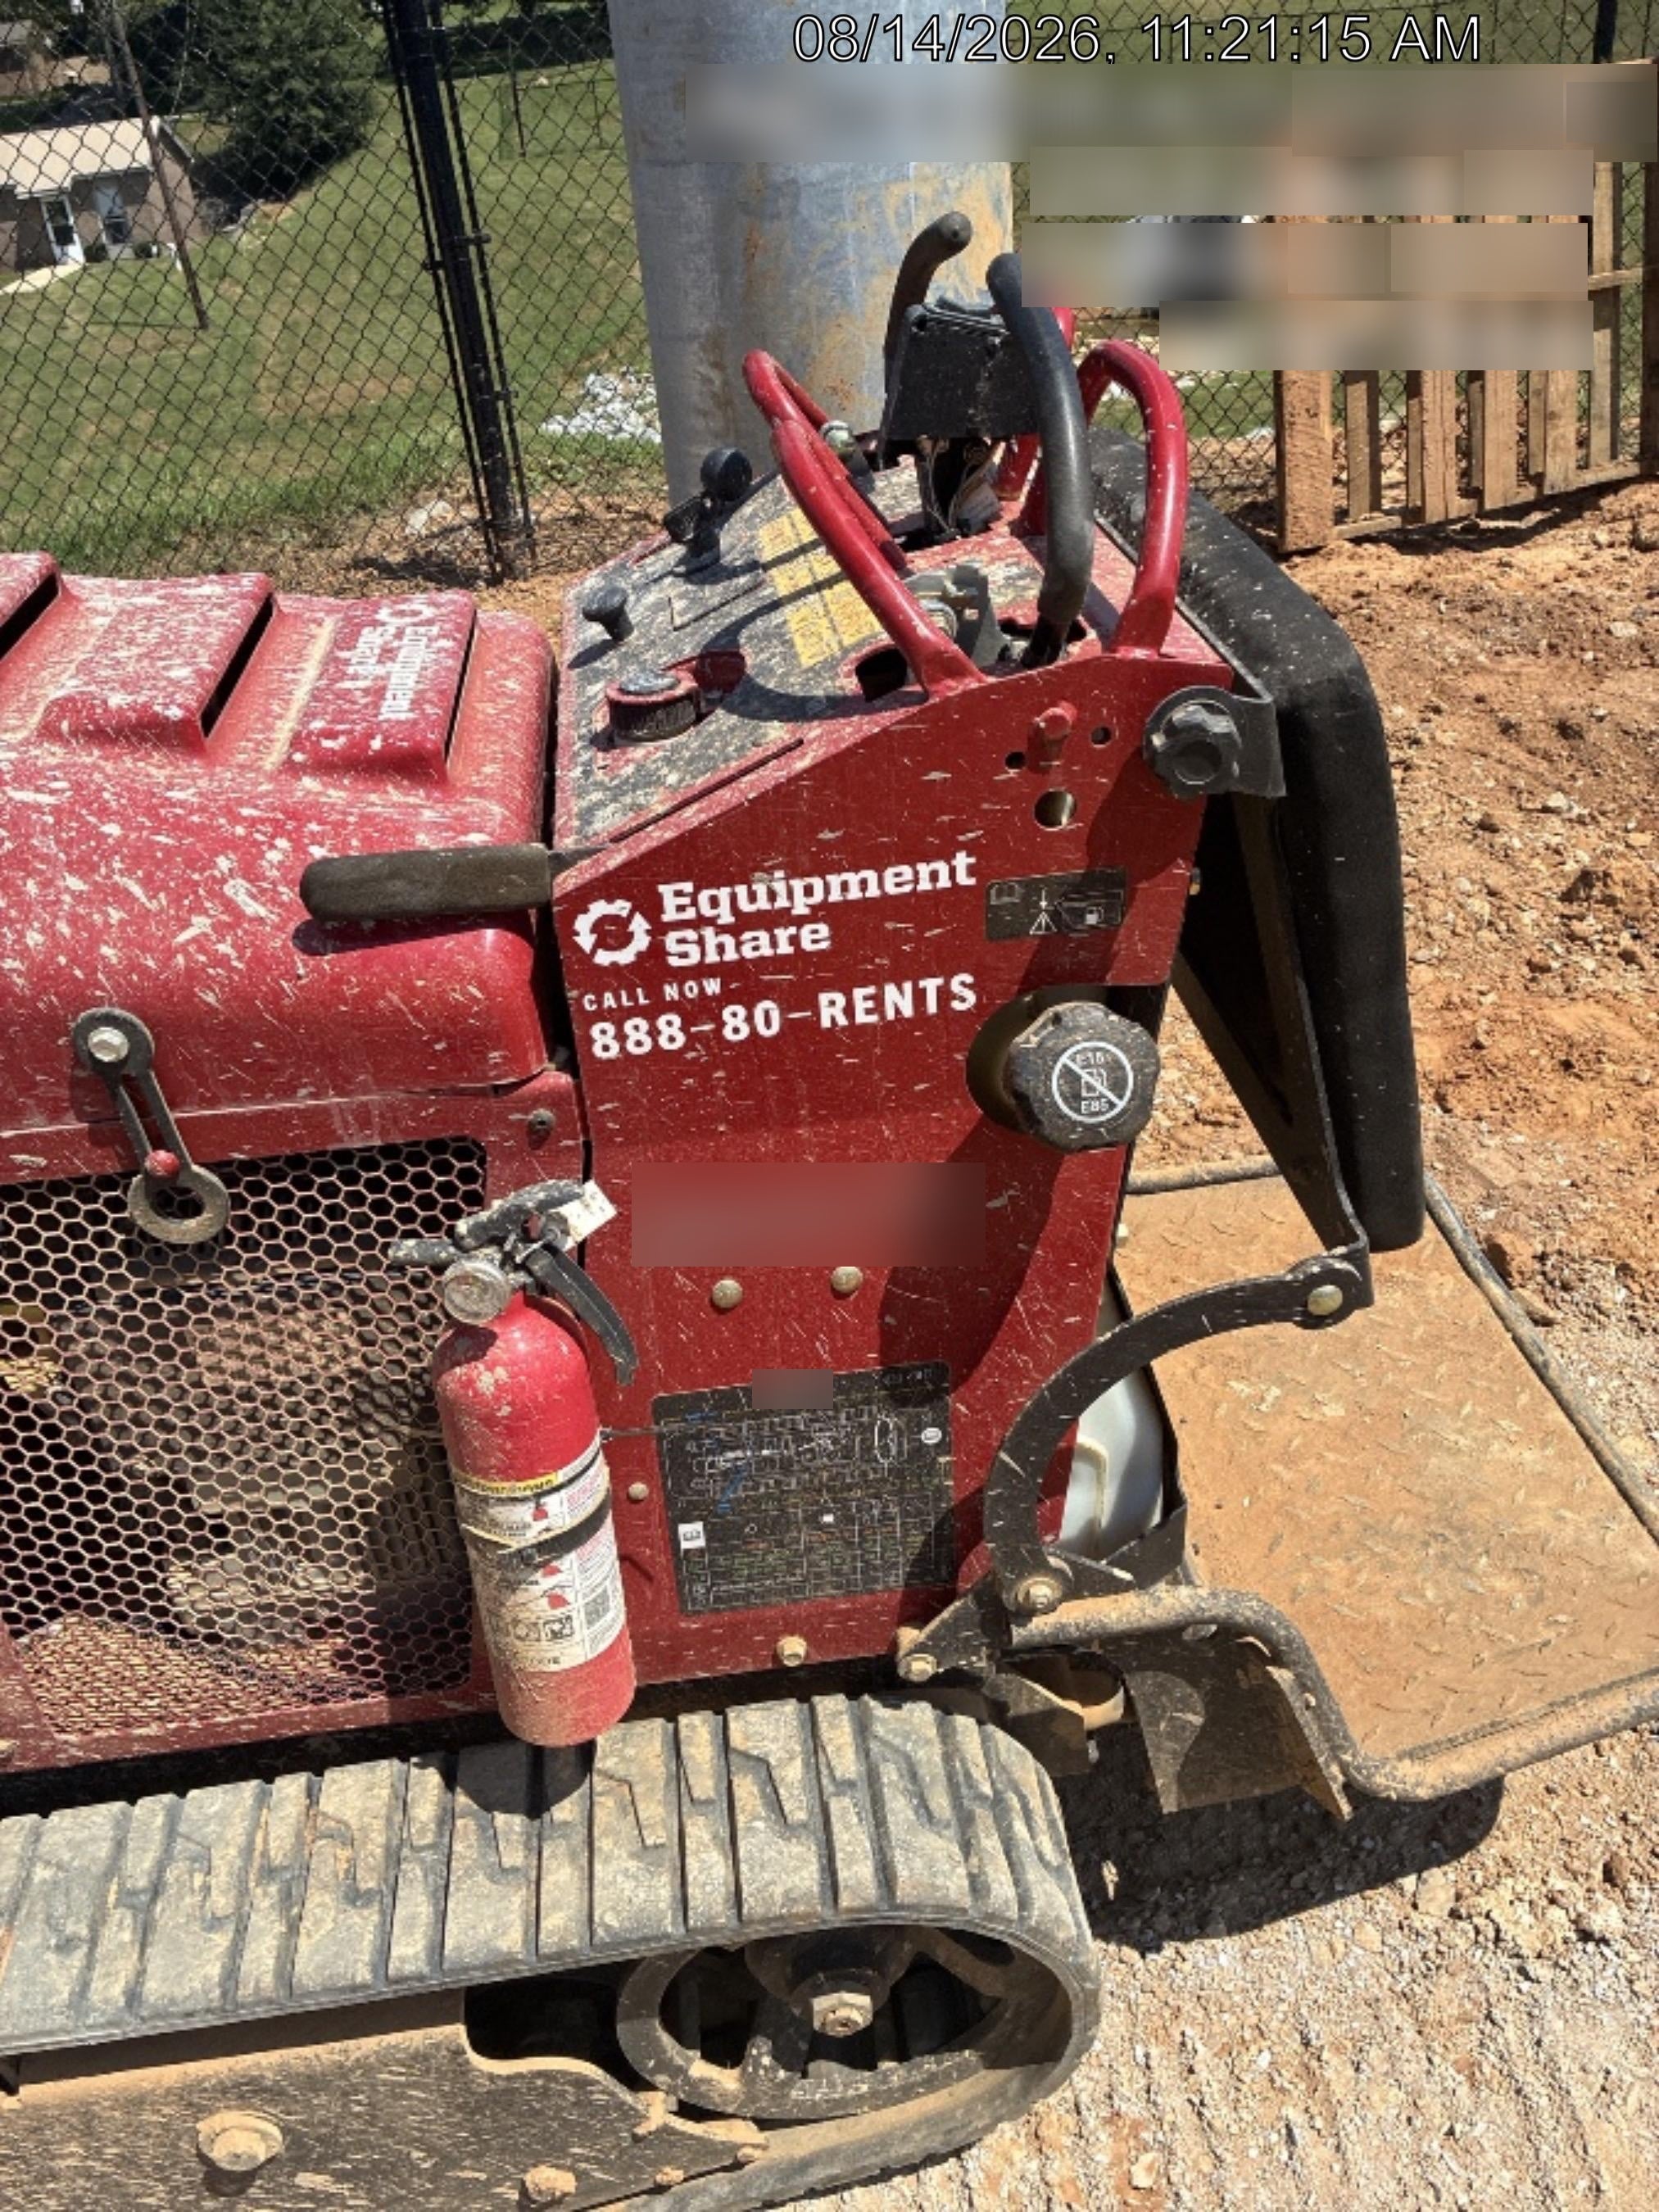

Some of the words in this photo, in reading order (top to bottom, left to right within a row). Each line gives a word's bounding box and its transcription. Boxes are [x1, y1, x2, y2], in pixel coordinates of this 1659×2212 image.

[656, 850, 977, 925] Equipment
[664, 922, 832, 968] Share
[582, 987, 650, 1012] CALL
[663, 977, 722, 1002] NOW
[589, 972, 977, 1060] 888-80-RENTS
[1081, 1098, 1109, 1113] E85
